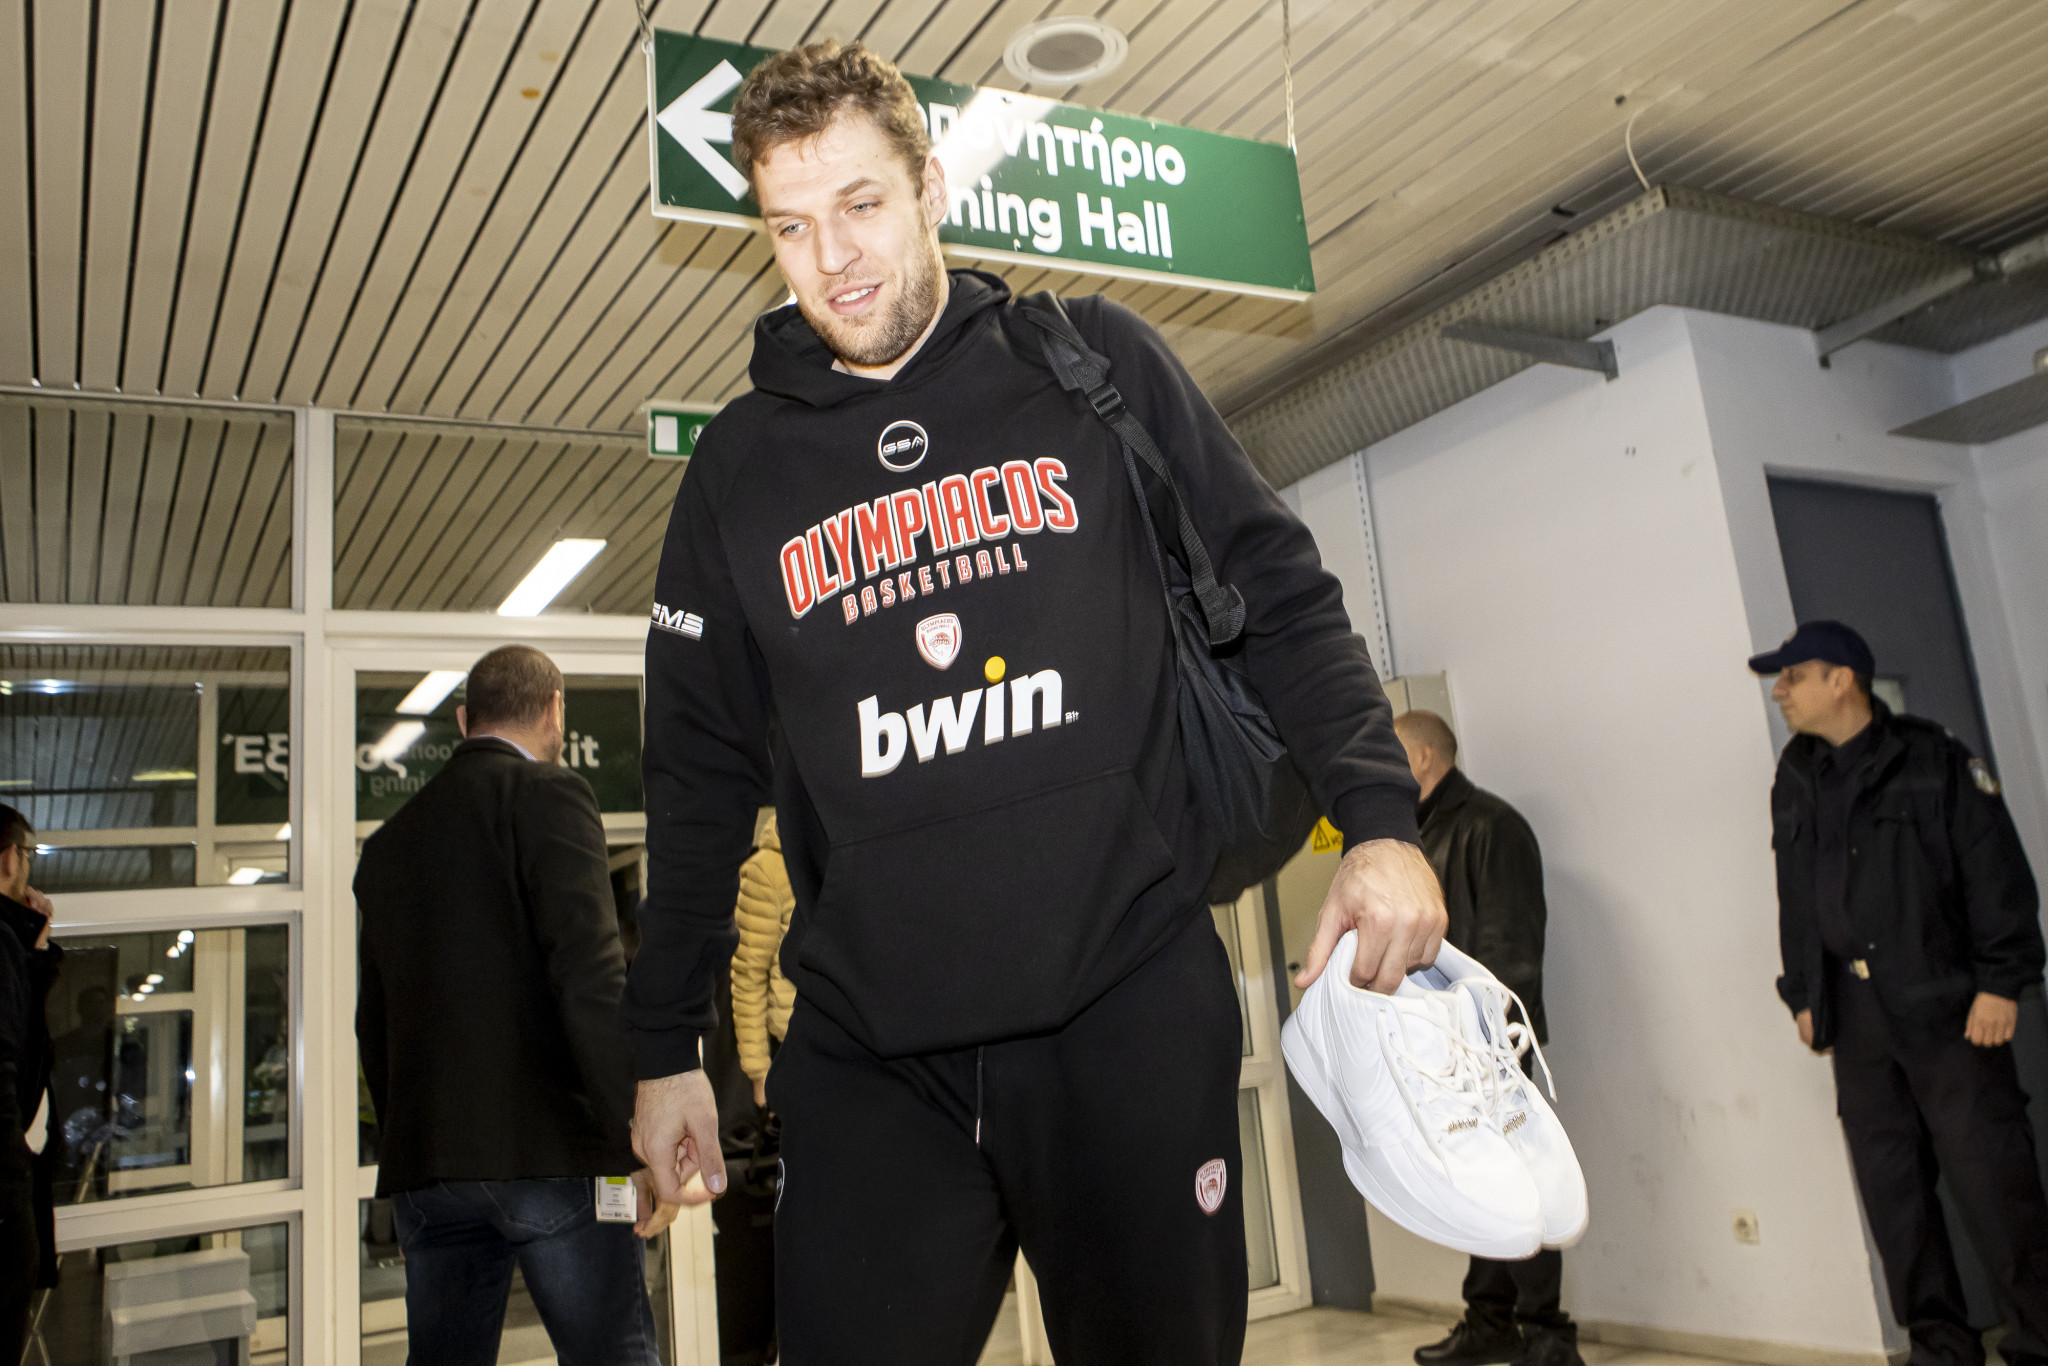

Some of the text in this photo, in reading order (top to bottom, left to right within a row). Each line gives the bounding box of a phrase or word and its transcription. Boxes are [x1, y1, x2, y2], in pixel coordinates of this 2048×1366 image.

[940, 174, 1173, 259] ning Hall
[882, 435, 925, 456] GSA
[780, 457, 1078, 619] OLYMPIACOS
[842, 543, 1028, 625] BASKETBALL
[558, 730, 600, 768] it
[857, 656, 1062, 778] bwin
